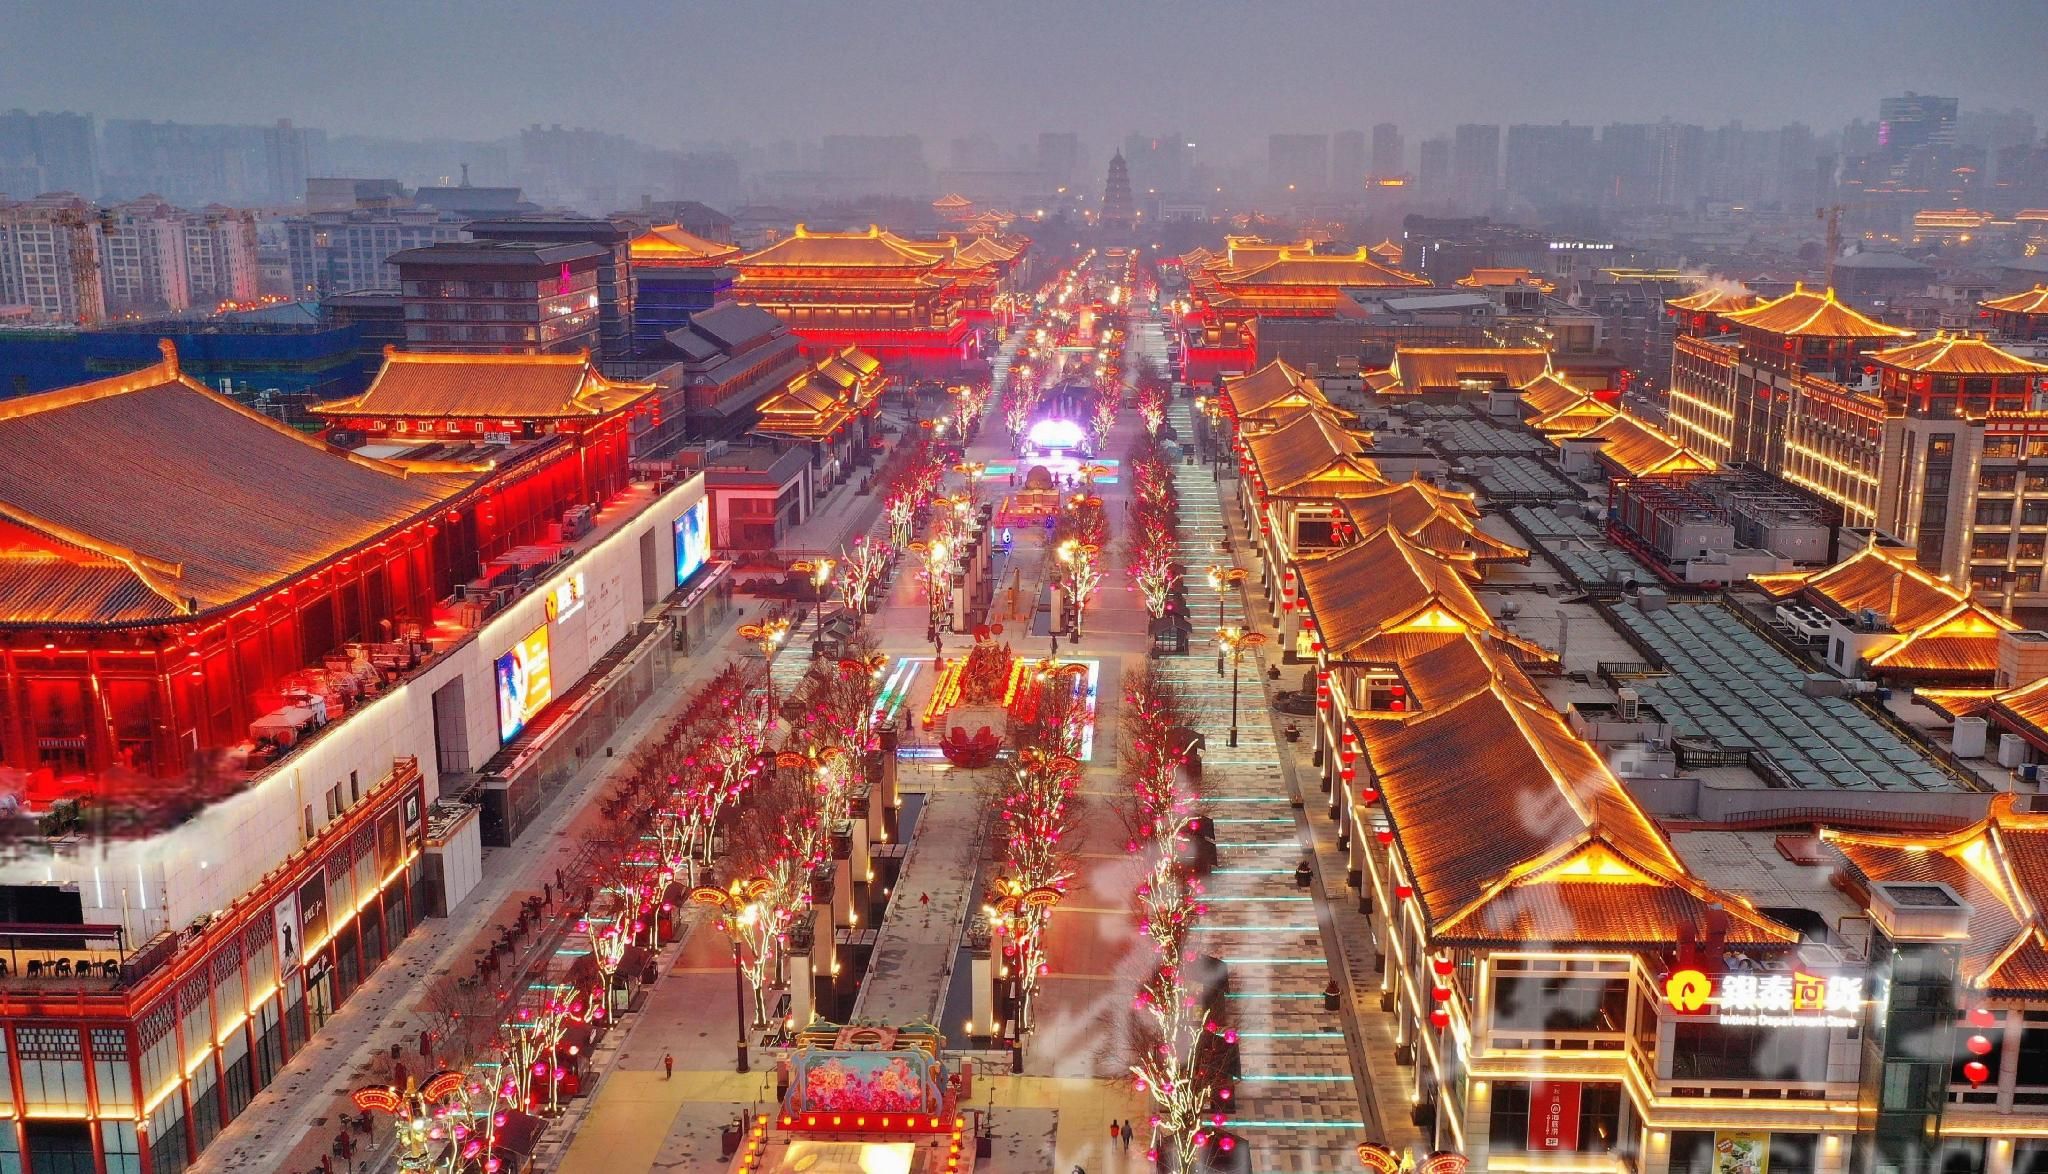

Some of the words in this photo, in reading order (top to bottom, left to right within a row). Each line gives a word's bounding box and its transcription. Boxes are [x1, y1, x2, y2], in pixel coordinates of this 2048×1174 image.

[1720, 1014, 1757, 1026] Intime
[1758, 1014, 1826, 1028] Department
[1827, 1015, 1857, 1028] Store
